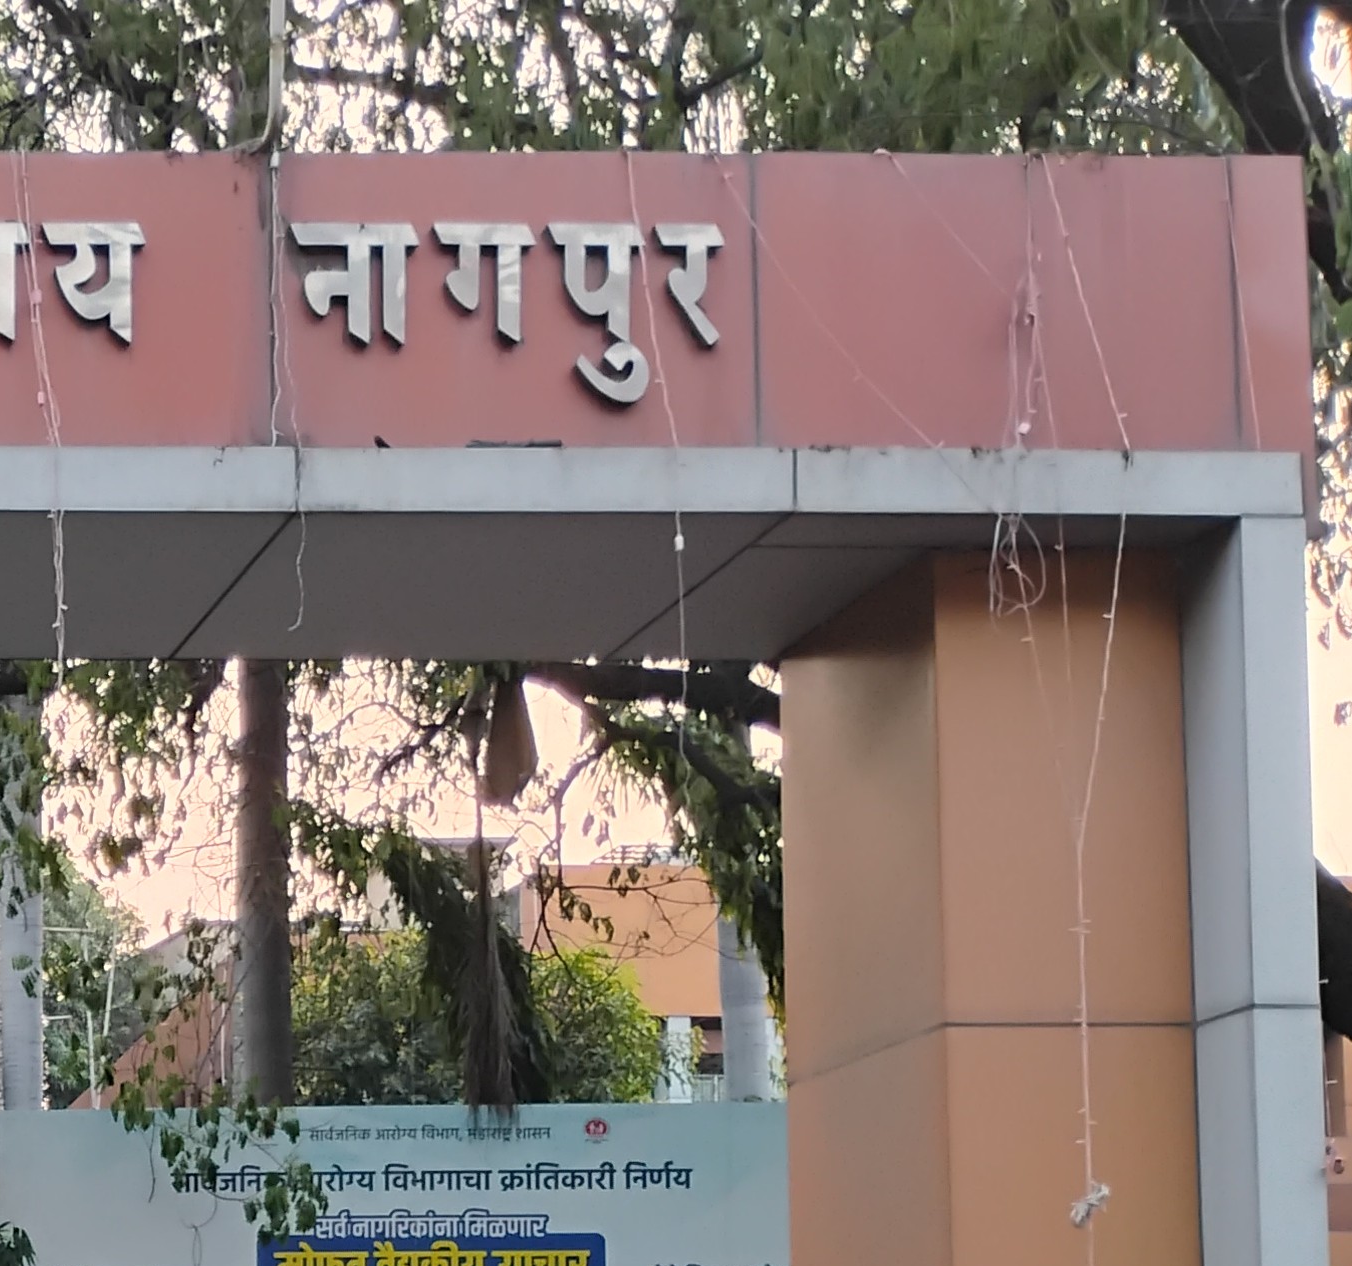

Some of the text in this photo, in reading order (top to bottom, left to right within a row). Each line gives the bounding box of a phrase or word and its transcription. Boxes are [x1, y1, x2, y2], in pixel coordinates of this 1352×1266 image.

[288, 220, 726, 411] नागपुर
[309, 1125, 371, 1142] सार्वजनिक
[375, 1124, 417, 1141] आरोग्य
[515, 1125, 552, 1141] शासन
[295, 1163, 376, 1193] रोग्य
[383, 1164, 492, 1192] विभागाचा
[498, 1161, 617, 1191] क्रांतिकारी
[622, 1160, 693, 1190] निर्णय
[315, 1208, 549, 1239] सर्व नागरिकांना मिळणार
